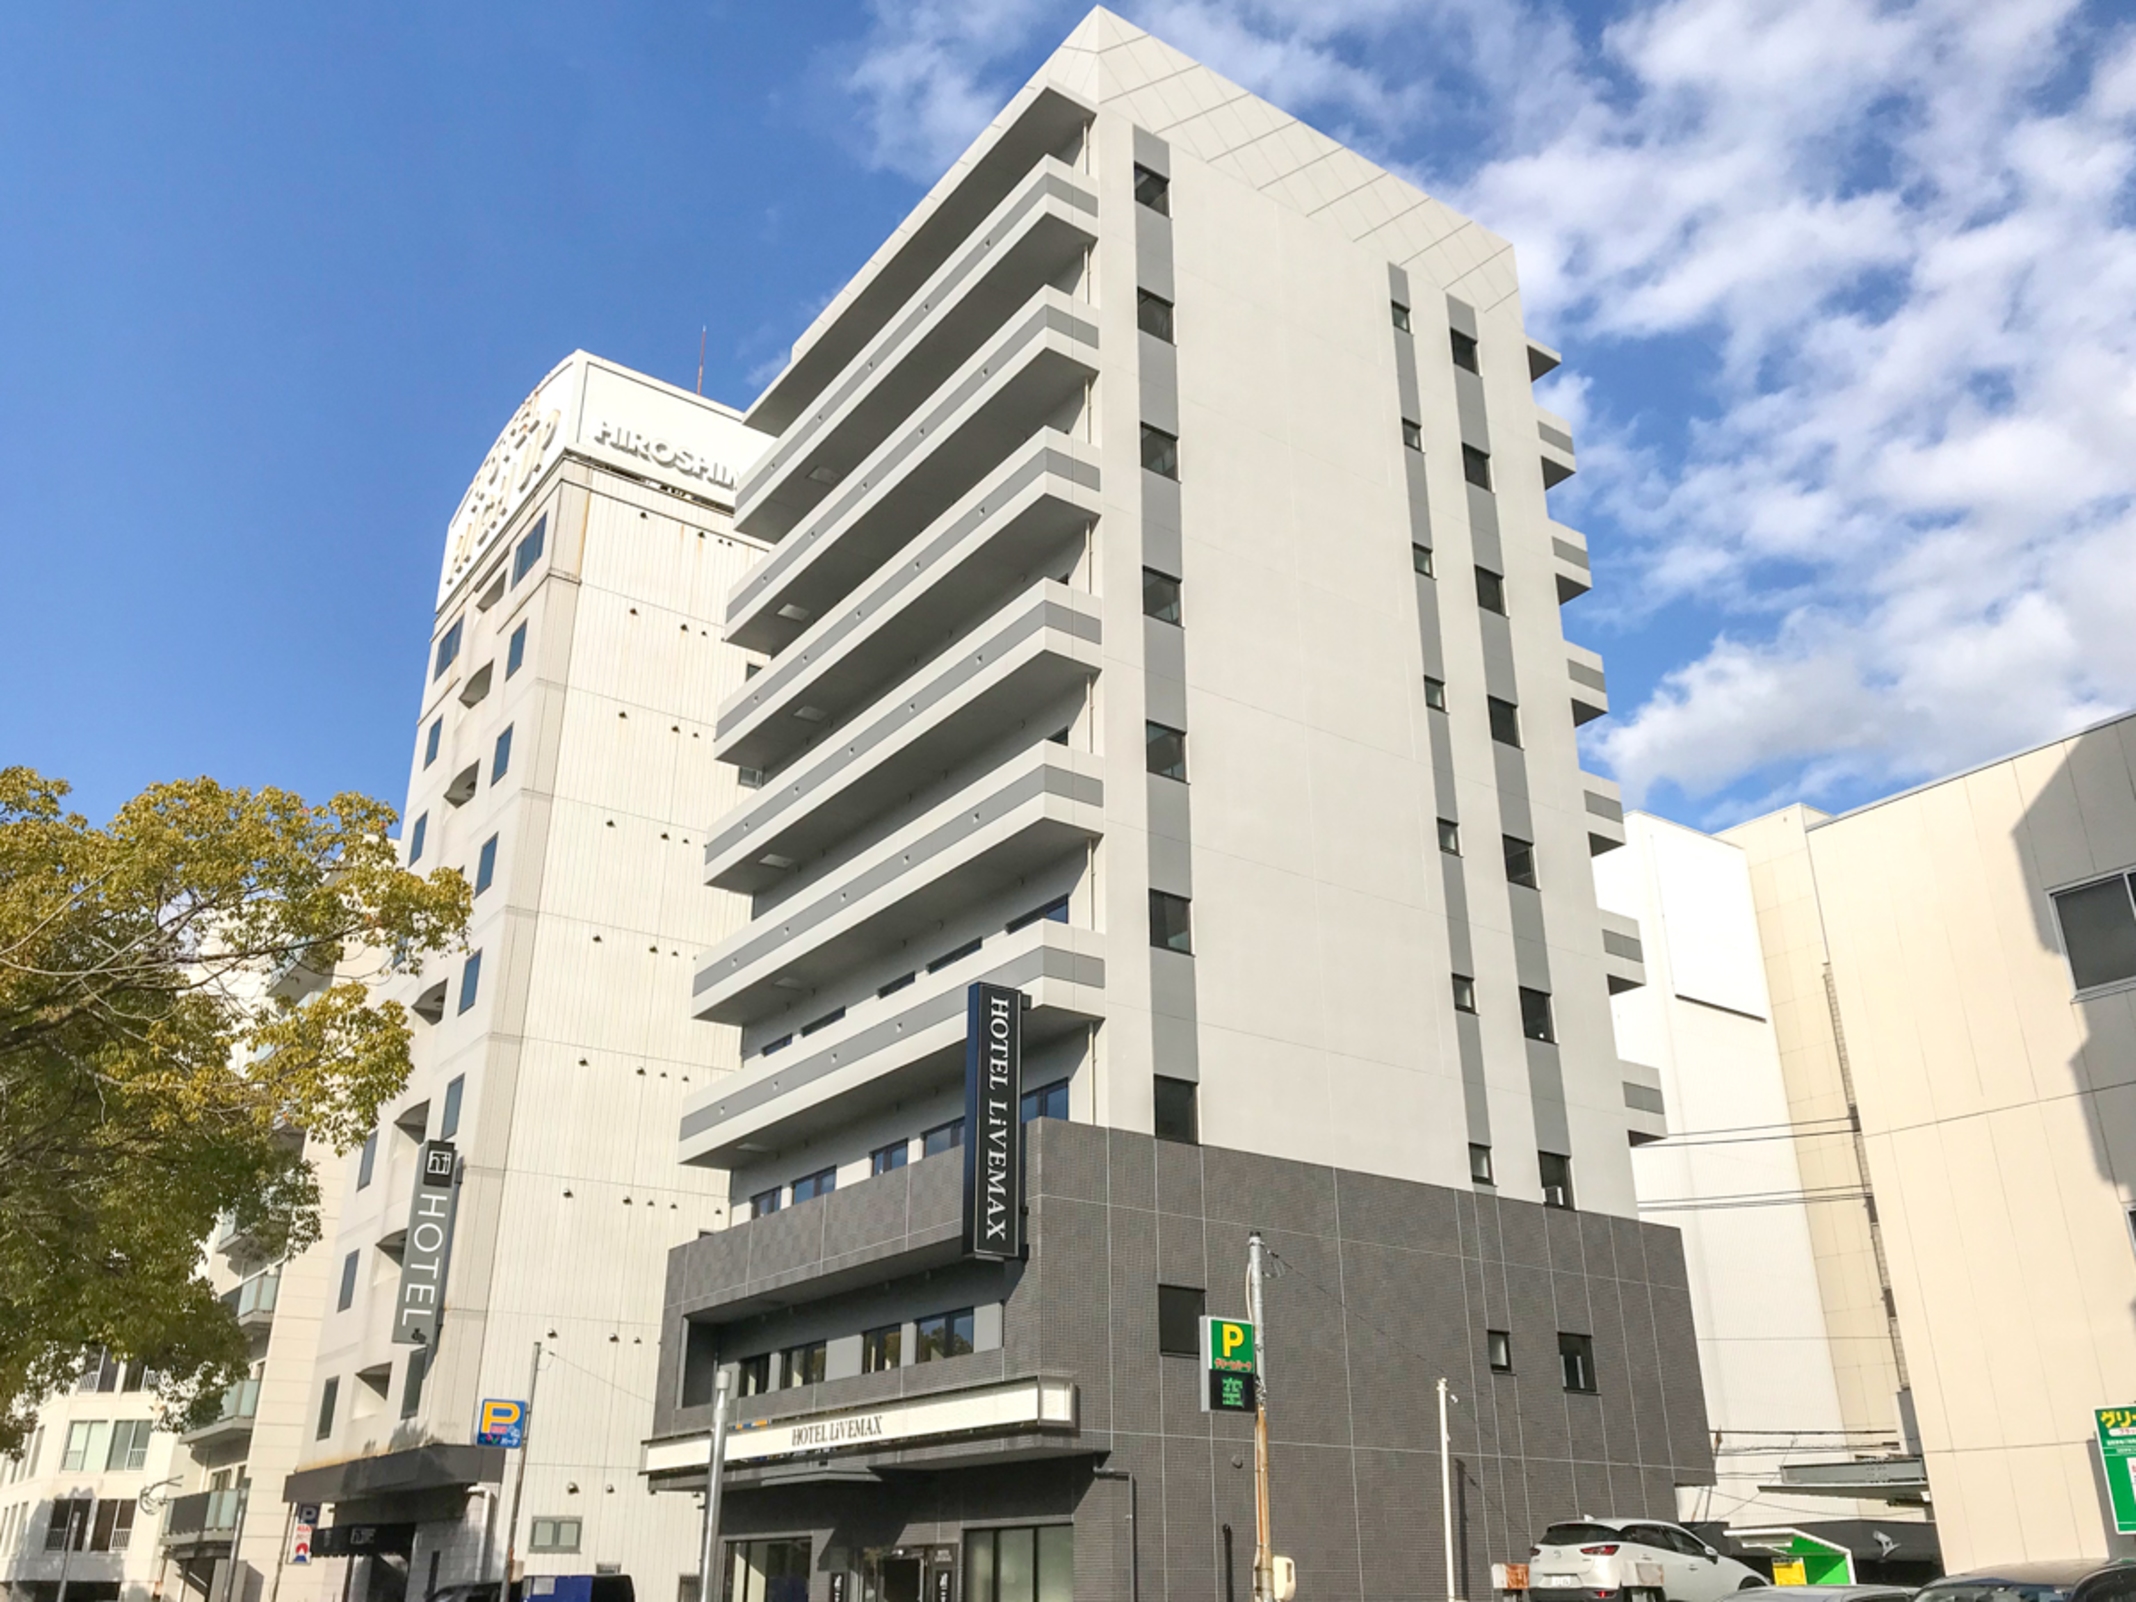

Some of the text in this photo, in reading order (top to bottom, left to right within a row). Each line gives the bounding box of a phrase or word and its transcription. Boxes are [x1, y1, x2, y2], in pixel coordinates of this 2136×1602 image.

[988, 995, 1009, 1091] HOTEL
[402, 1193, 448, 1327] HOTEL
[1222, 1323, 1244, 1357] P
[481, 1401, 520, 1433] P
[791, 1424, 827, 1446] HOTEL
